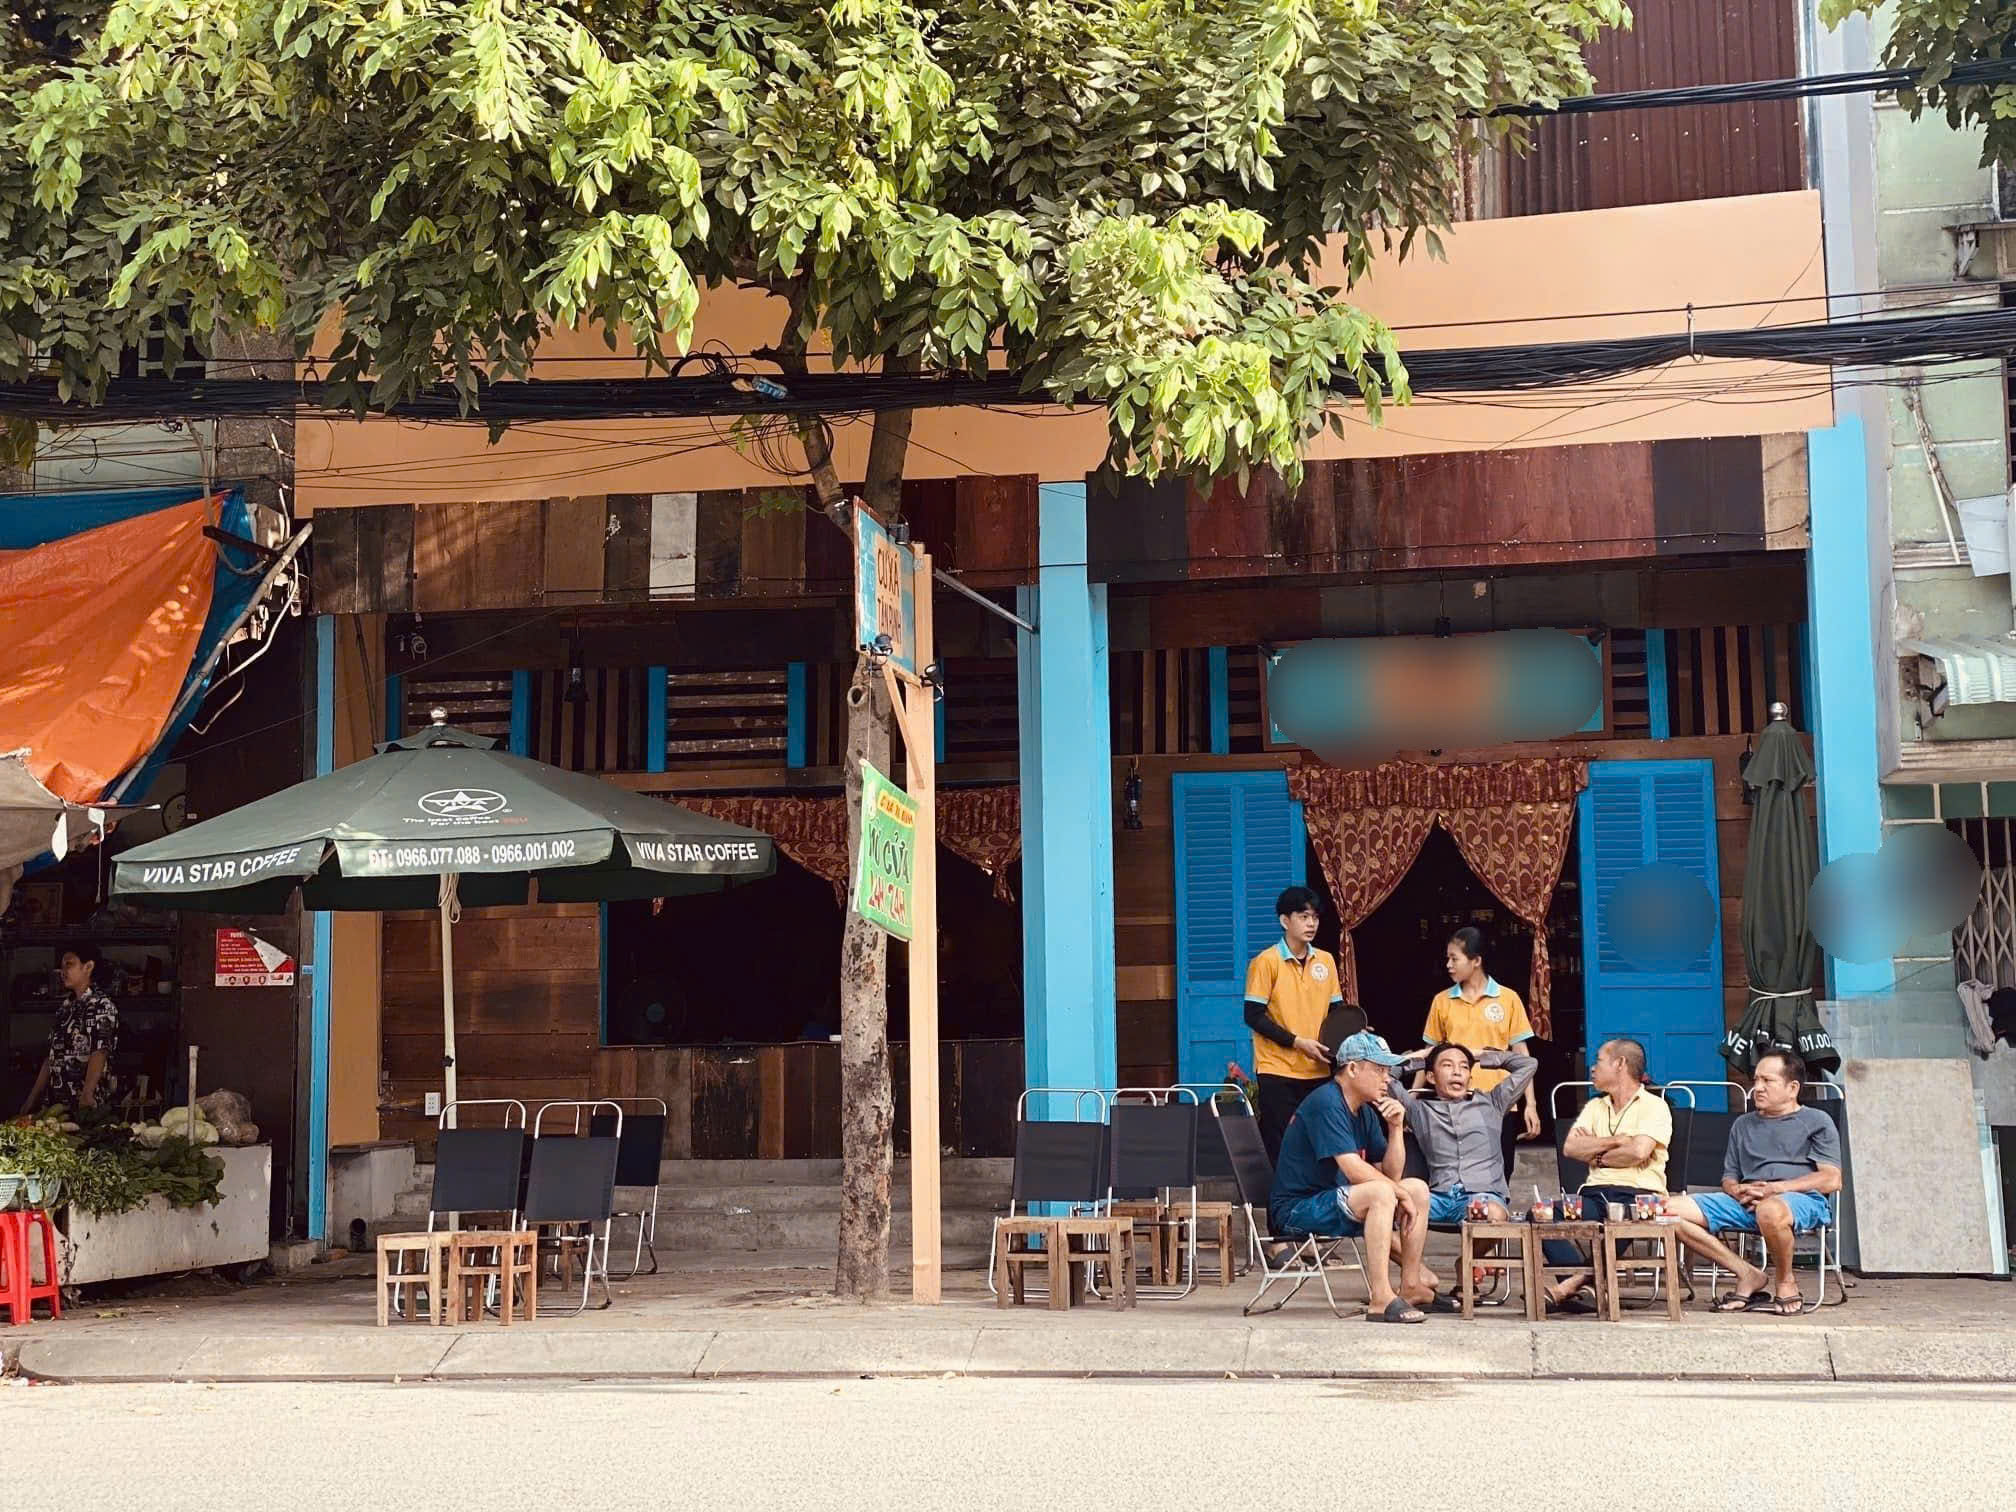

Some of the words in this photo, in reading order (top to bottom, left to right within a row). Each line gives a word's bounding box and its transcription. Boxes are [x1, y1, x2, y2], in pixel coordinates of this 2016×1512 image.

[143, 866, 185, 884] VIVA
[189, 860, 236, 883] STAR
[240, 847, 302, 877] COFFEE
[396, 845, 481, 868] 0966.077.088
[491, 839, 576, 864] 0966.001.002
[636, 841, 666, 862] VIVA
[667, 843, 704, 862] STAR
[704, 842, 760, 861] COFFEE
